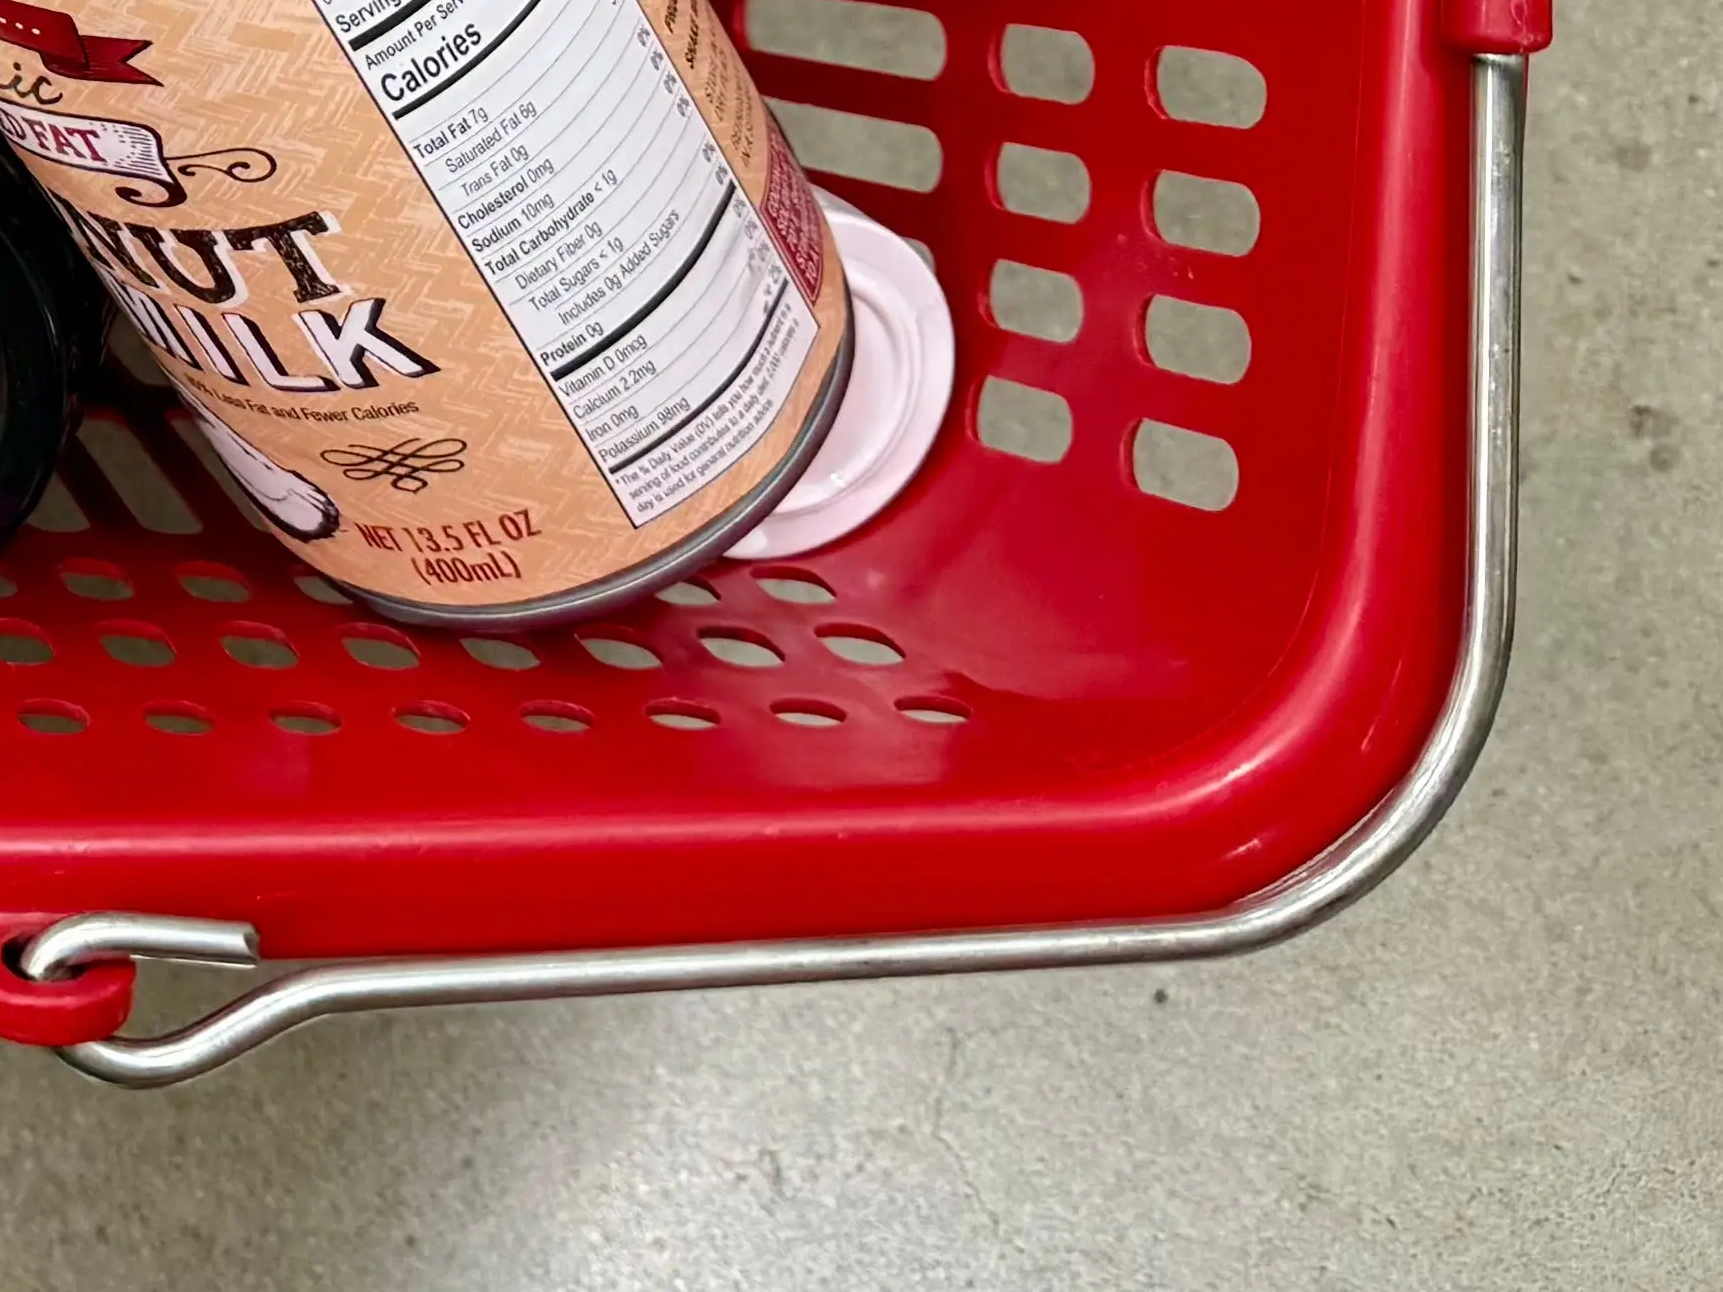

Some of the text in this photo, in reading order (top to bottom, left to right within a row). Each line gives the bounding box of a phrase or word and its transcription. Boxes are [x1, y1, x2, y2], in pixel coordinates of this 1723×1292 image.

[363, 30, 417, 71] Amount
[416, 17, 438, 39] Per
[380, 22, 483, 103] Calories
[21, 116, 109, 164] FAT
[413, 105, 490, 160] Total Fat 7g
[444, 100, 538, 175] Saturated Fat 6g
[456, 157, 555, 231] Cholesterol 0mg
[460, 142, 531, 199] Trans Fat 0g
[470, 191, 555, 253] Sodium 10mg
[484, 167, 619, 277] Total Carbohydrate 1g
[514, 219, 604, 291] Dietary Fiber 0g
[528, 236, 625, 313] Total Sugars 1g
[557, 208, 681, 326] Includes 0g Added Sugars
[539, 320, 605, 368] Protein 0g
[558, 332, 649, 398] Vitamin D 0mcg
[247, 398, 272, 415] Fat
[273, 403, 300, 420] and
[301, 406, 350, 422] Fewer
[352, 399, 420, 422] Calories
[572, 359, 657, 420] Calcium 2.2mg
[584, 404, 640, 443] Iron 0mg
[597, 395, 692, 463] Potassium 98mg
[354, 508, 543, 555] NET 13.5 FL OZ
[410, 550, 522, 587] (400mL)
